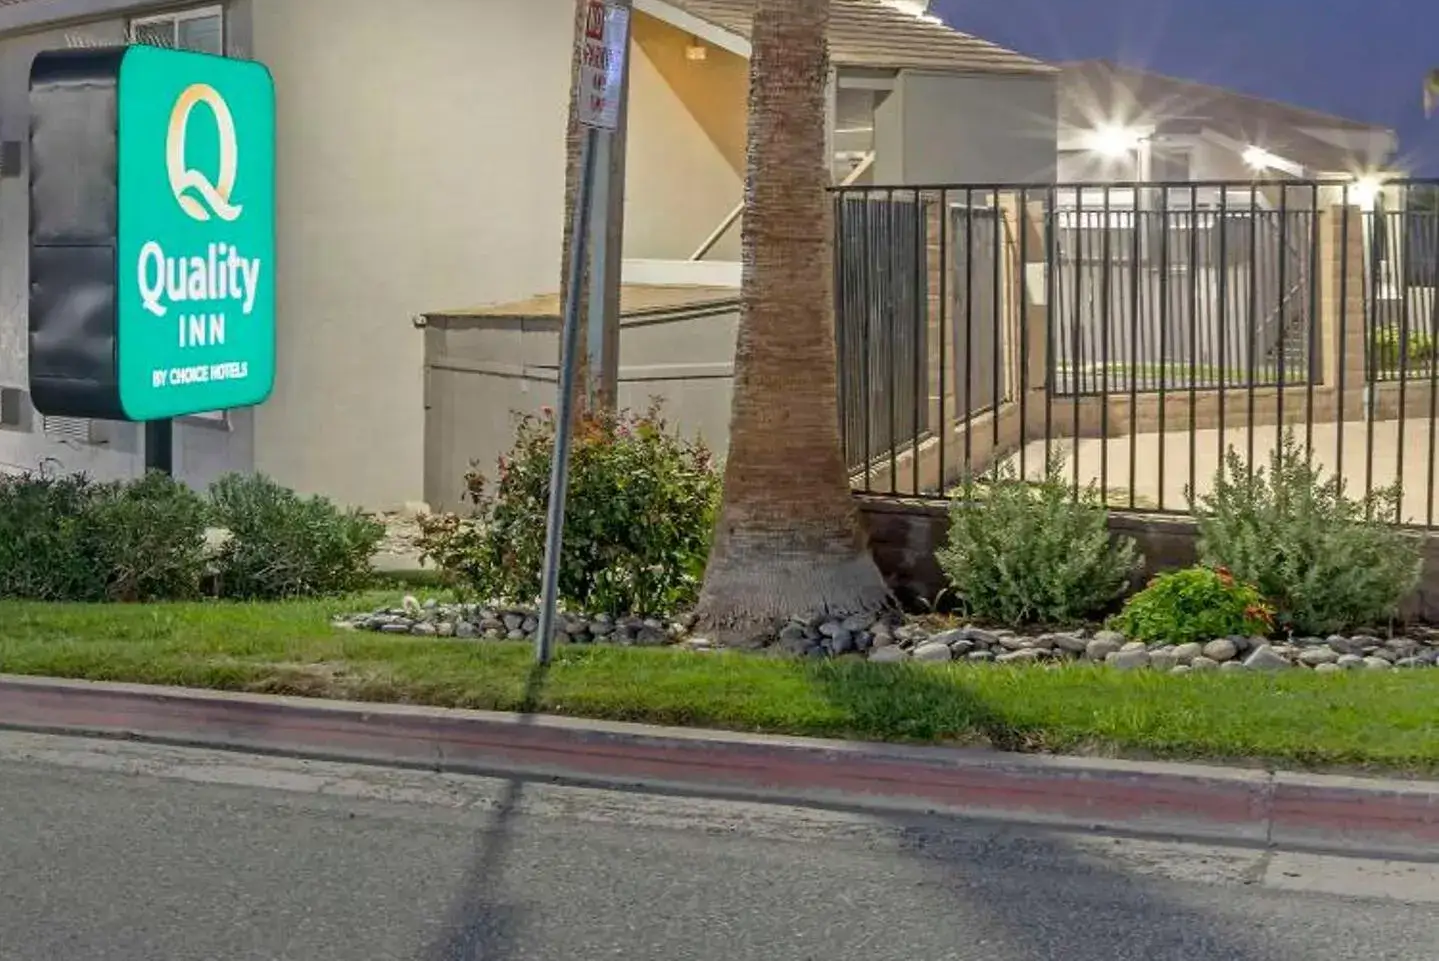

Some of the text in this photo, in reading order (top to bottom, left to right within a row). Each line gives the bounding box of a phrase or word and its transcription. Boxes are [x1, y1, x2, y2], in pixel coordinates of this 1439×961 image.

[166, 84, 242, 221] Q
[137, 241, 260, 316] Quality
[178, 313, 225, 347] INN
[152, 361, 248, 387] BY CHOICE HOTELS
